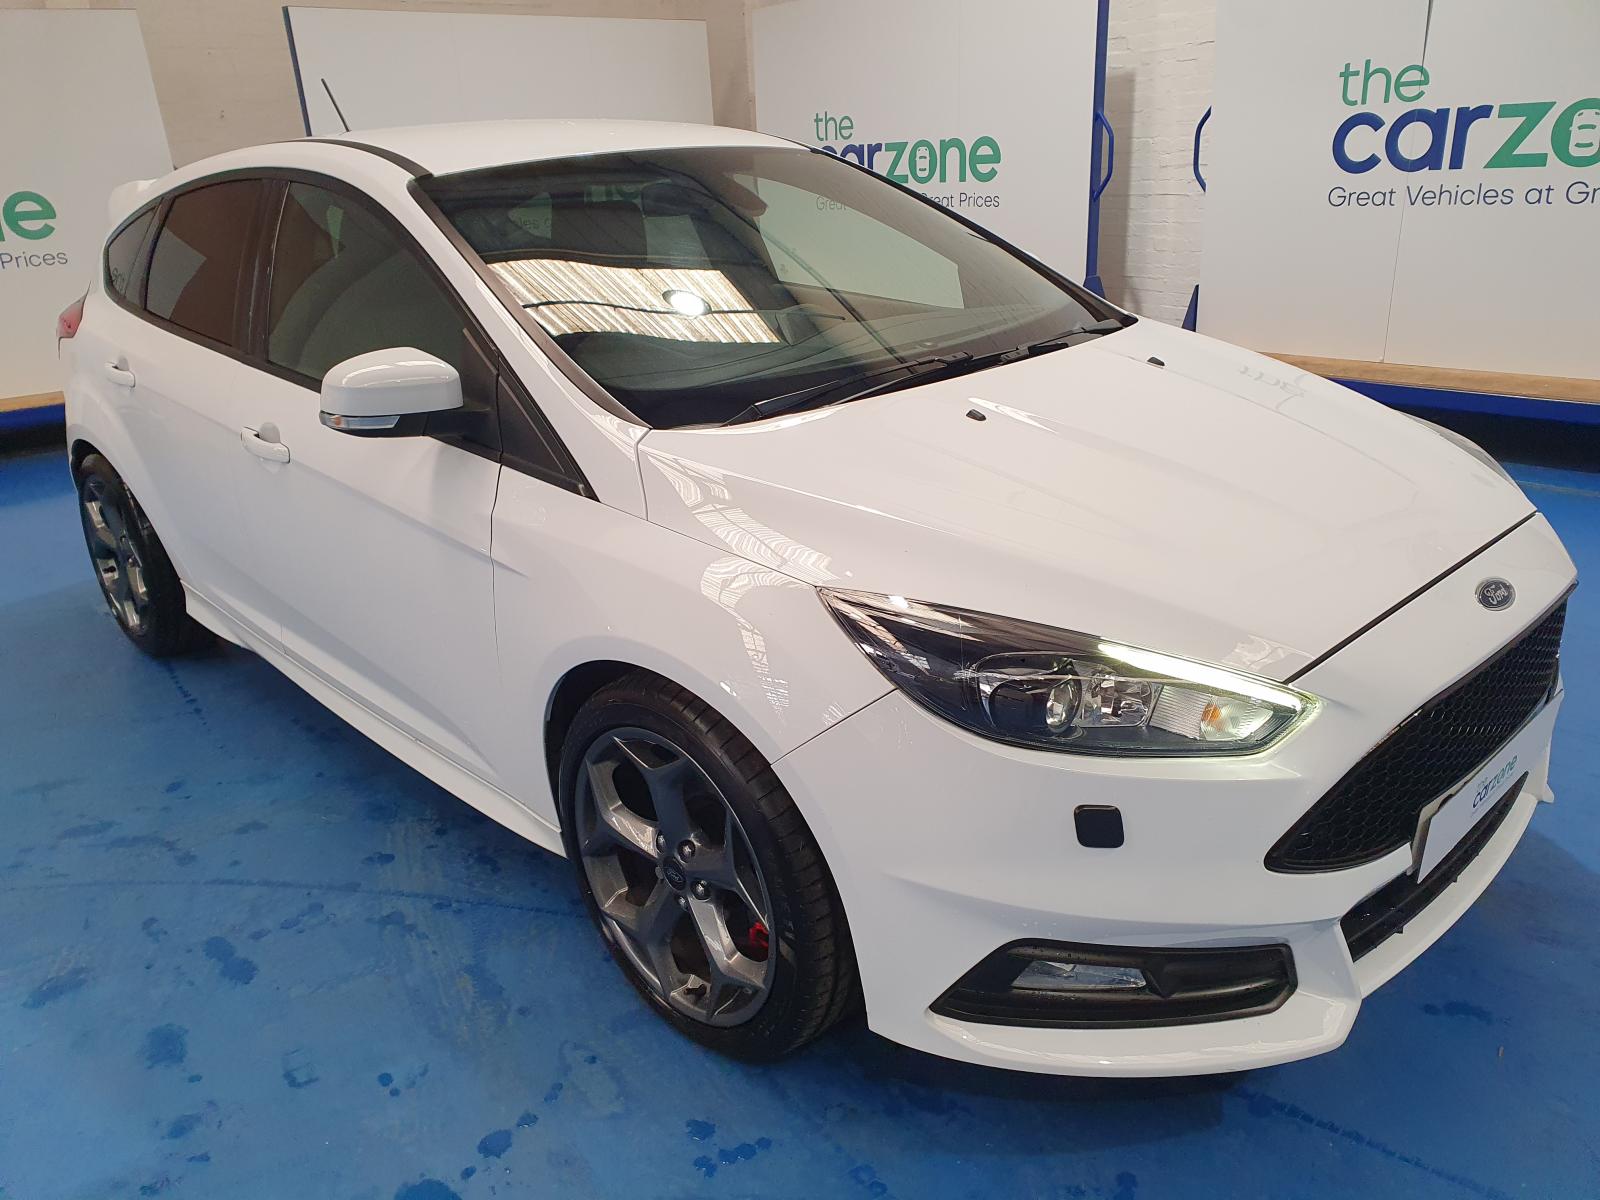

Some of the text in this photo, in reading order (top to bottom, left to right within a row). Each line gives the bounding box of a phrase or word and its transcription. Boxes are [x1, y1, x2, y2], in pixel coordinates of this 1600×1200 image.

[1339, 59, 1430, 106] the
[814, 111, 854, 141] the
[959, 192, 1000, 208] Prices
[1328, 186, 1396, 207] Great
[1406, 182, 1514, 206] Vehicles
[1524, 184, 1554, 205] at
[0, 191, 57, 241] e
[0, 251, 68, 269] Prices
